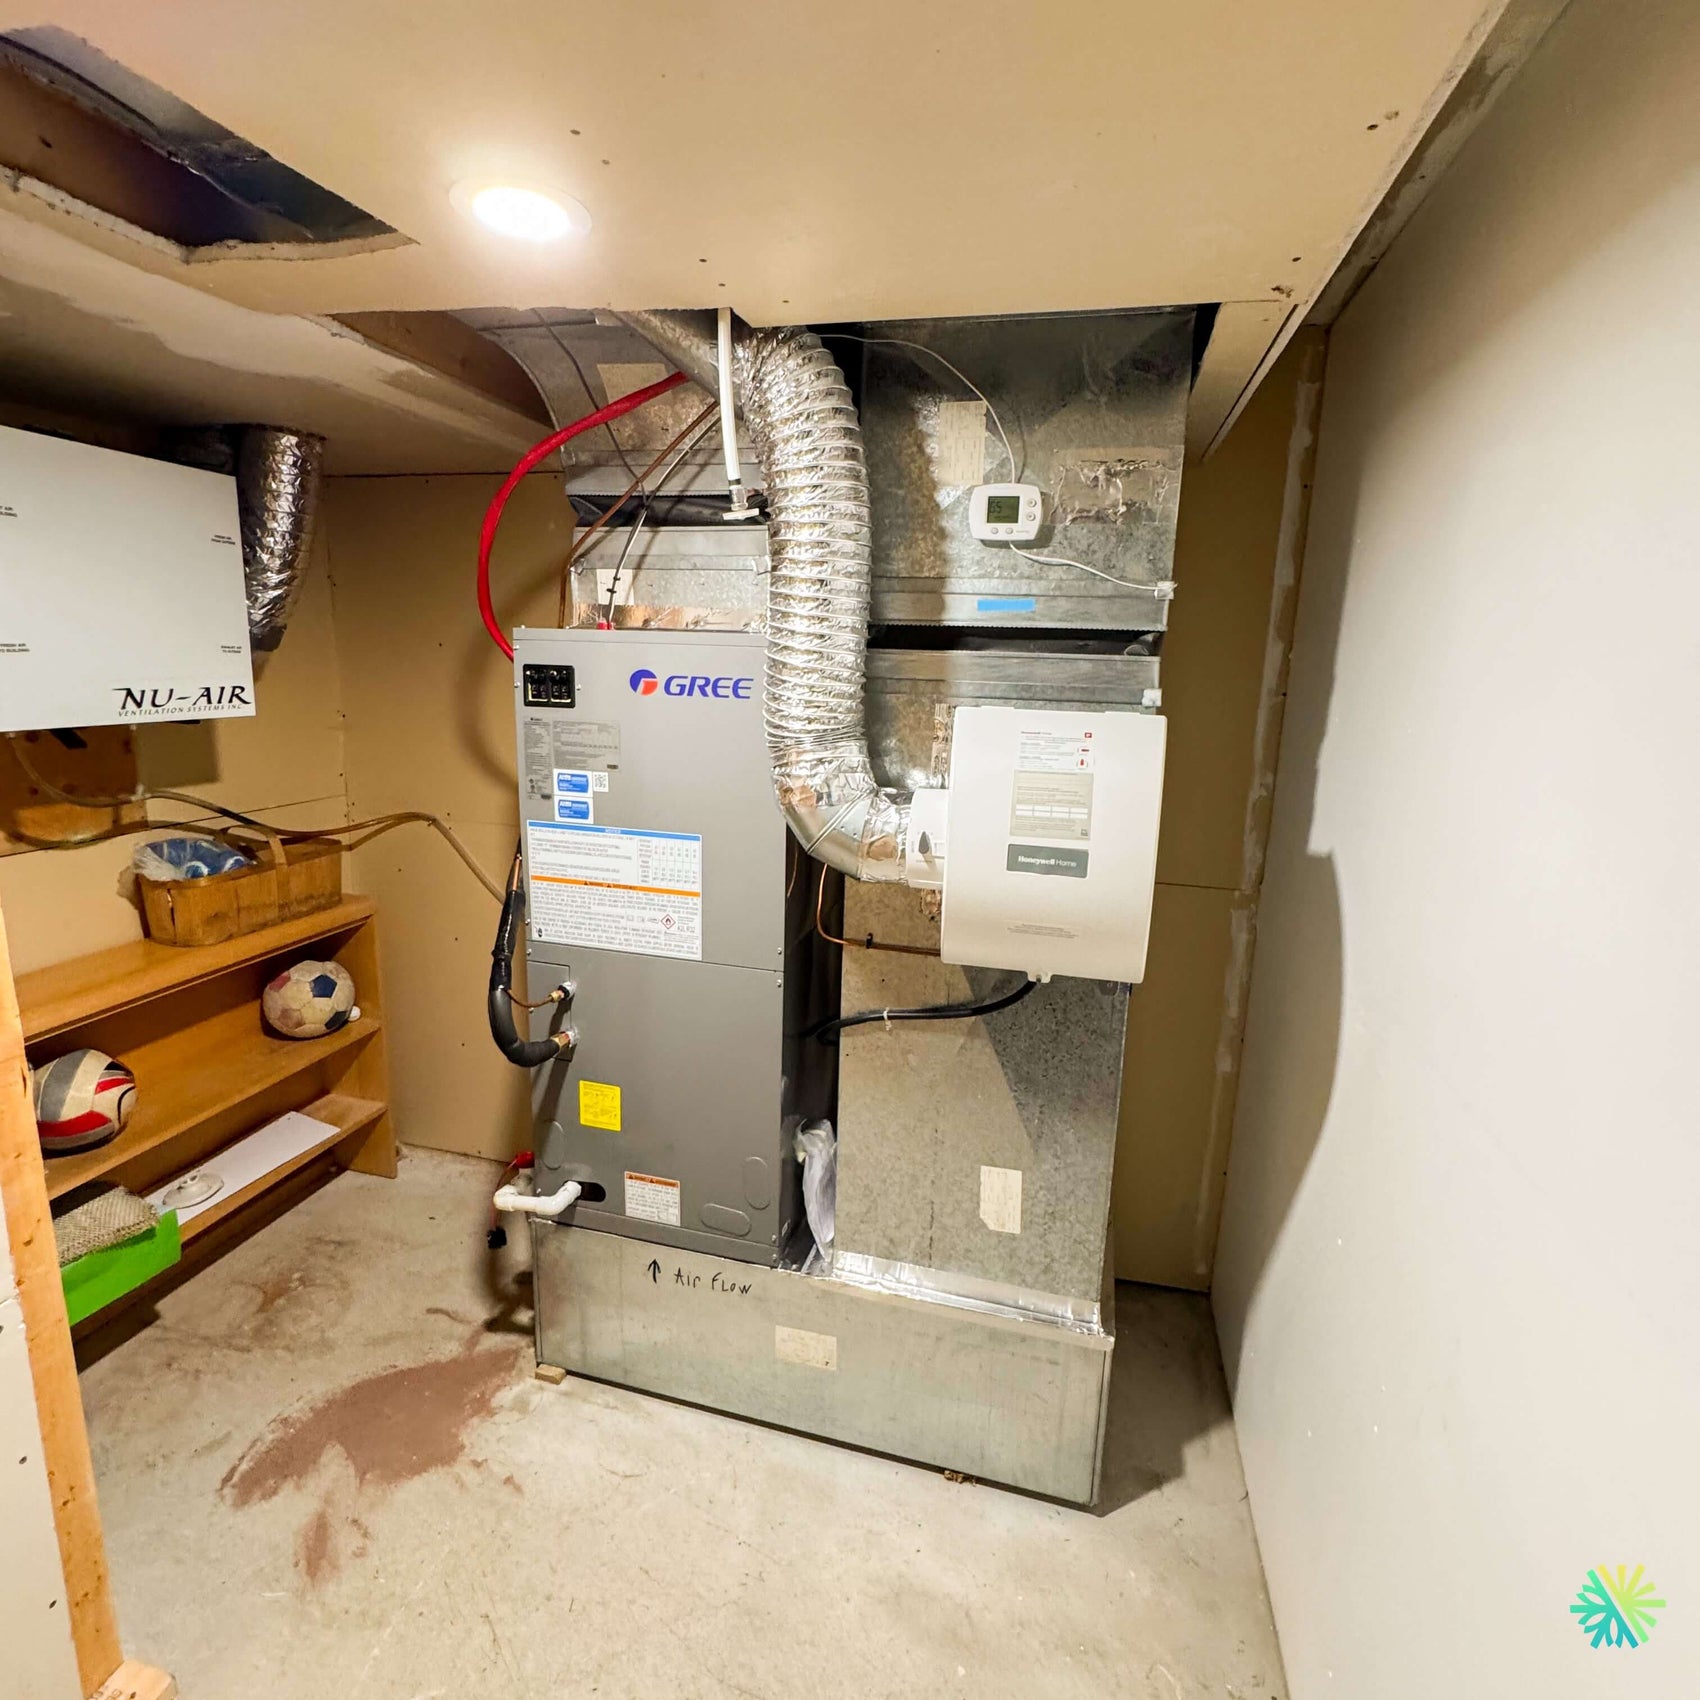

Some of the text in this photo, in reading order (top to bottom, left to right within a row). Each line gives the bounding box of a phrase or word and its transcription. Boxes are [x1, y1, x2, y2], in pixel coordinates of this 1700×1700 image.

[111, 685, 252, 710] NU-AIR
[663, 675, 754, 699] GREE
[118, 708, 184, 717] VENTILATION
[187, 705, 225, 713] SYSTEMS
[1018, 855, 1077, 867] Honeywell Home
[674, 1267, 701, 1289] Air
